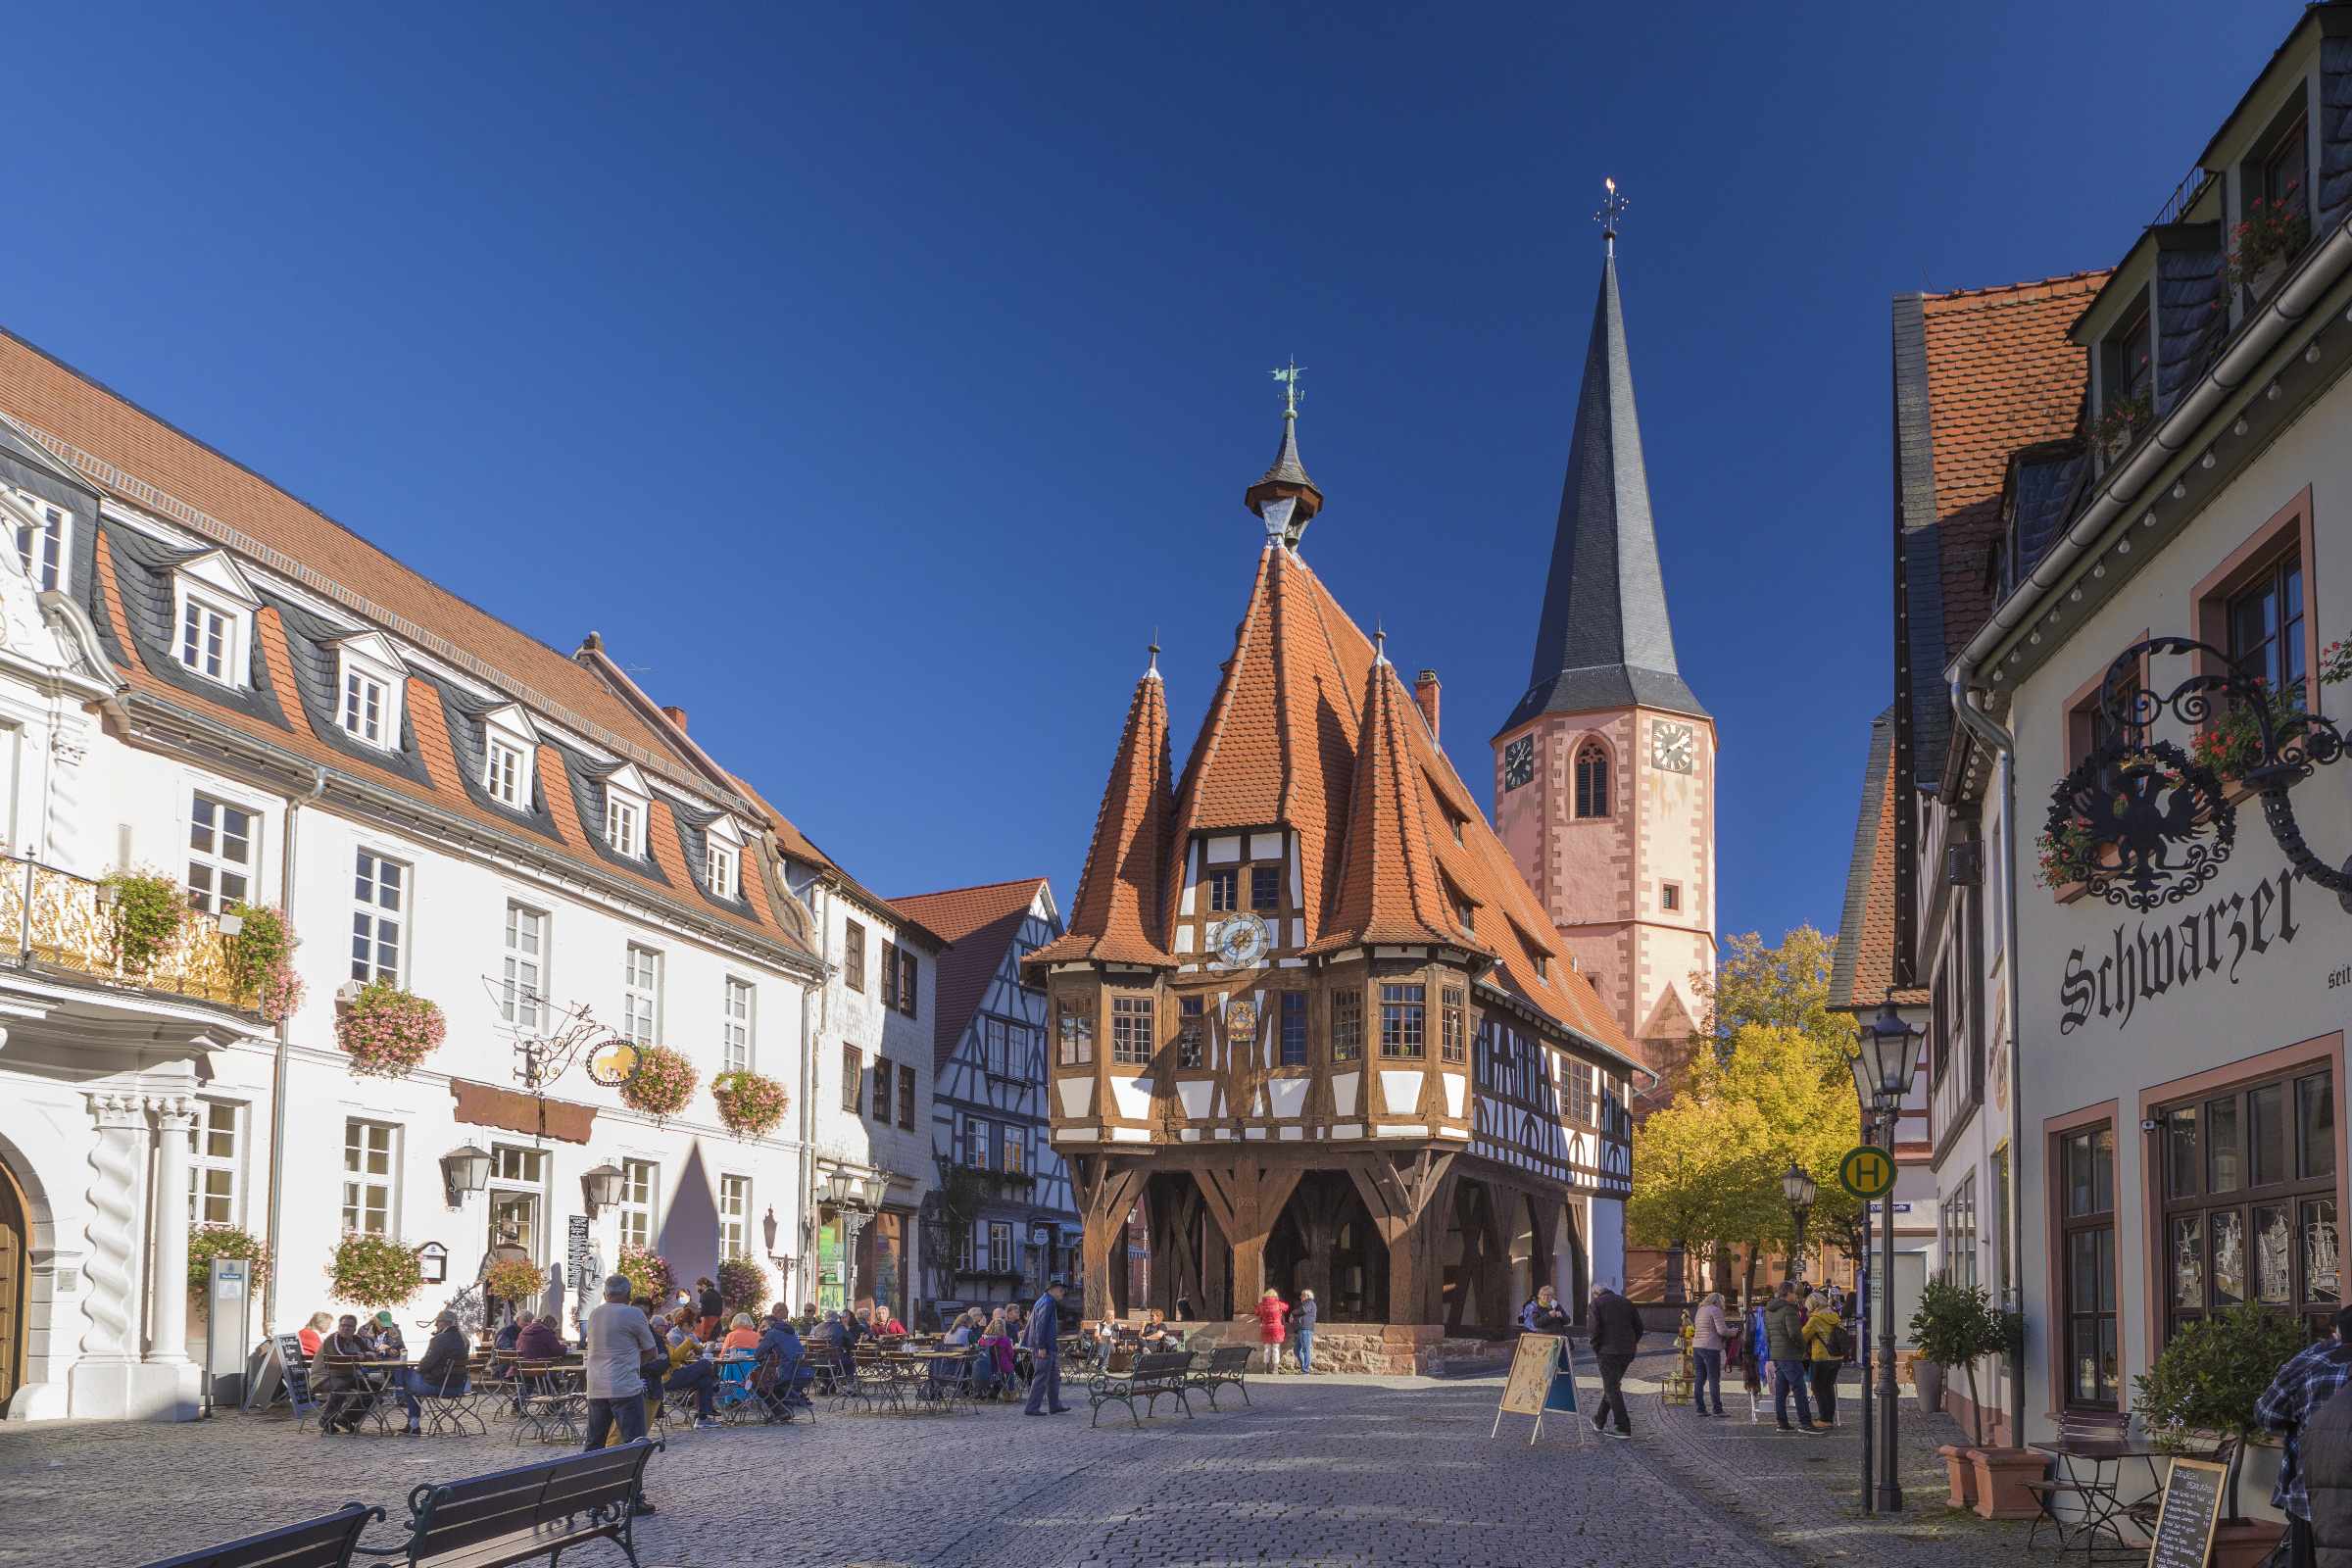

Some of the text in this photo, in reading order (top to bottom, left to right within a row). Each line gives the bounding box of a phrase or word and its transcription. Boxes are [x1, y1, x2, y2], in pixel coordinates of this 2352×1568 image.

[2060, 866, 2304, 1035] Schwarzer
[2328, 964, 2352, 989] seit
[471, 1089, 583, 1130] Leyhasen
[1857, 1158, 1880, 1187] H
